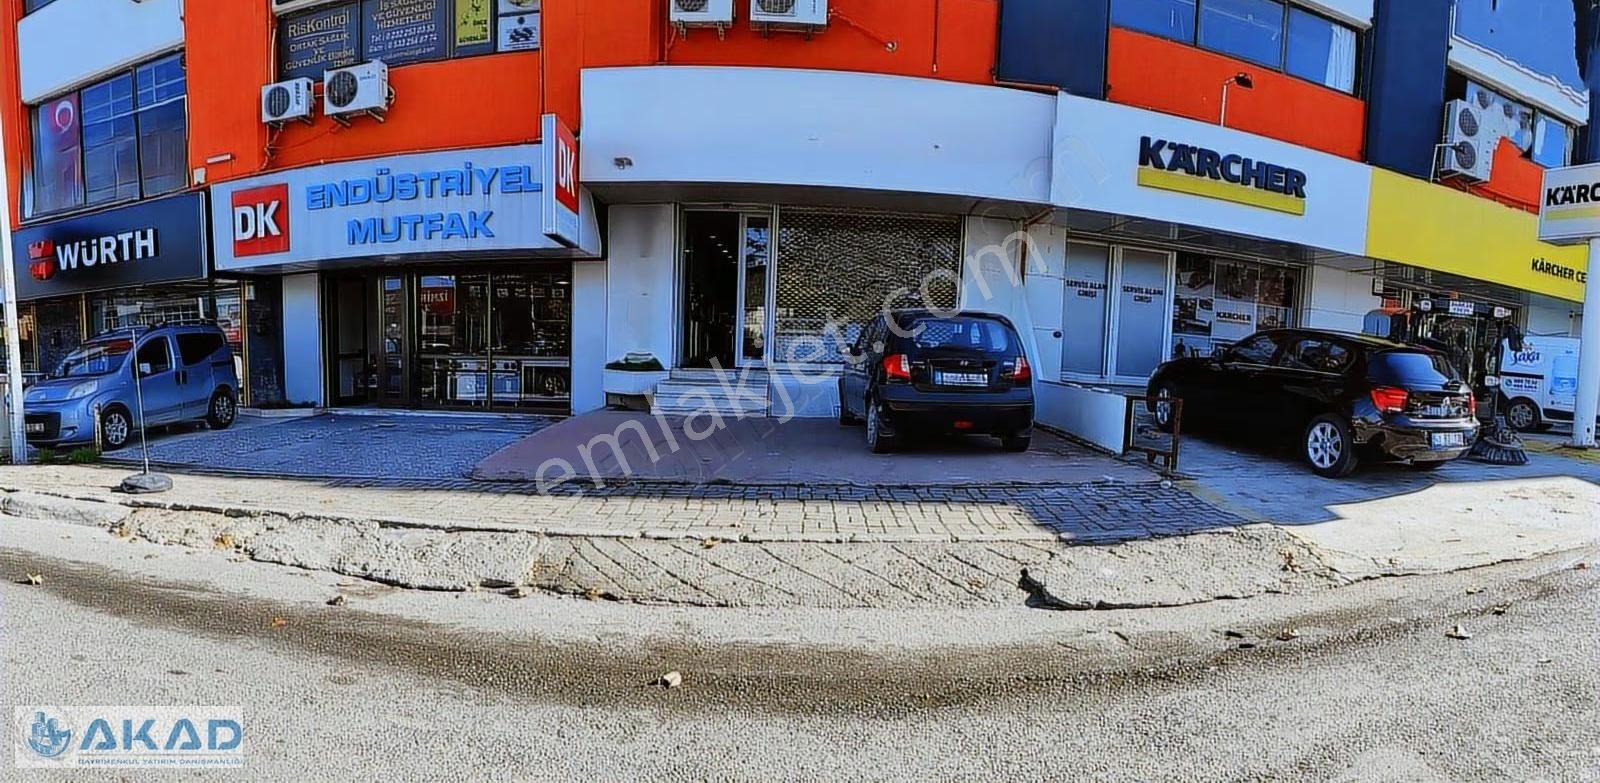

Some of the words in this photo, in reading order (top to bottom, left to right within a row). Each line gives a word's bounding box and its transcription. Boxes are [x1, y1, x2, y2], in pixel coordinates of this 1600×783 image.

[288, 10, 350, 38] RisKontrol
[306, 161, 543, 211] ENDÜSTRİYEL
[559, 137, 576, 198] DK
[1139, 136, 1307, 198] KÄRCHER
[234, 200, 281, 241] DK
[347, 210, 495, 245] MUTFAK
[56, 228, 155, 271] WÜRTH
[1532, 258, 1575, 280] KÄRCHER
